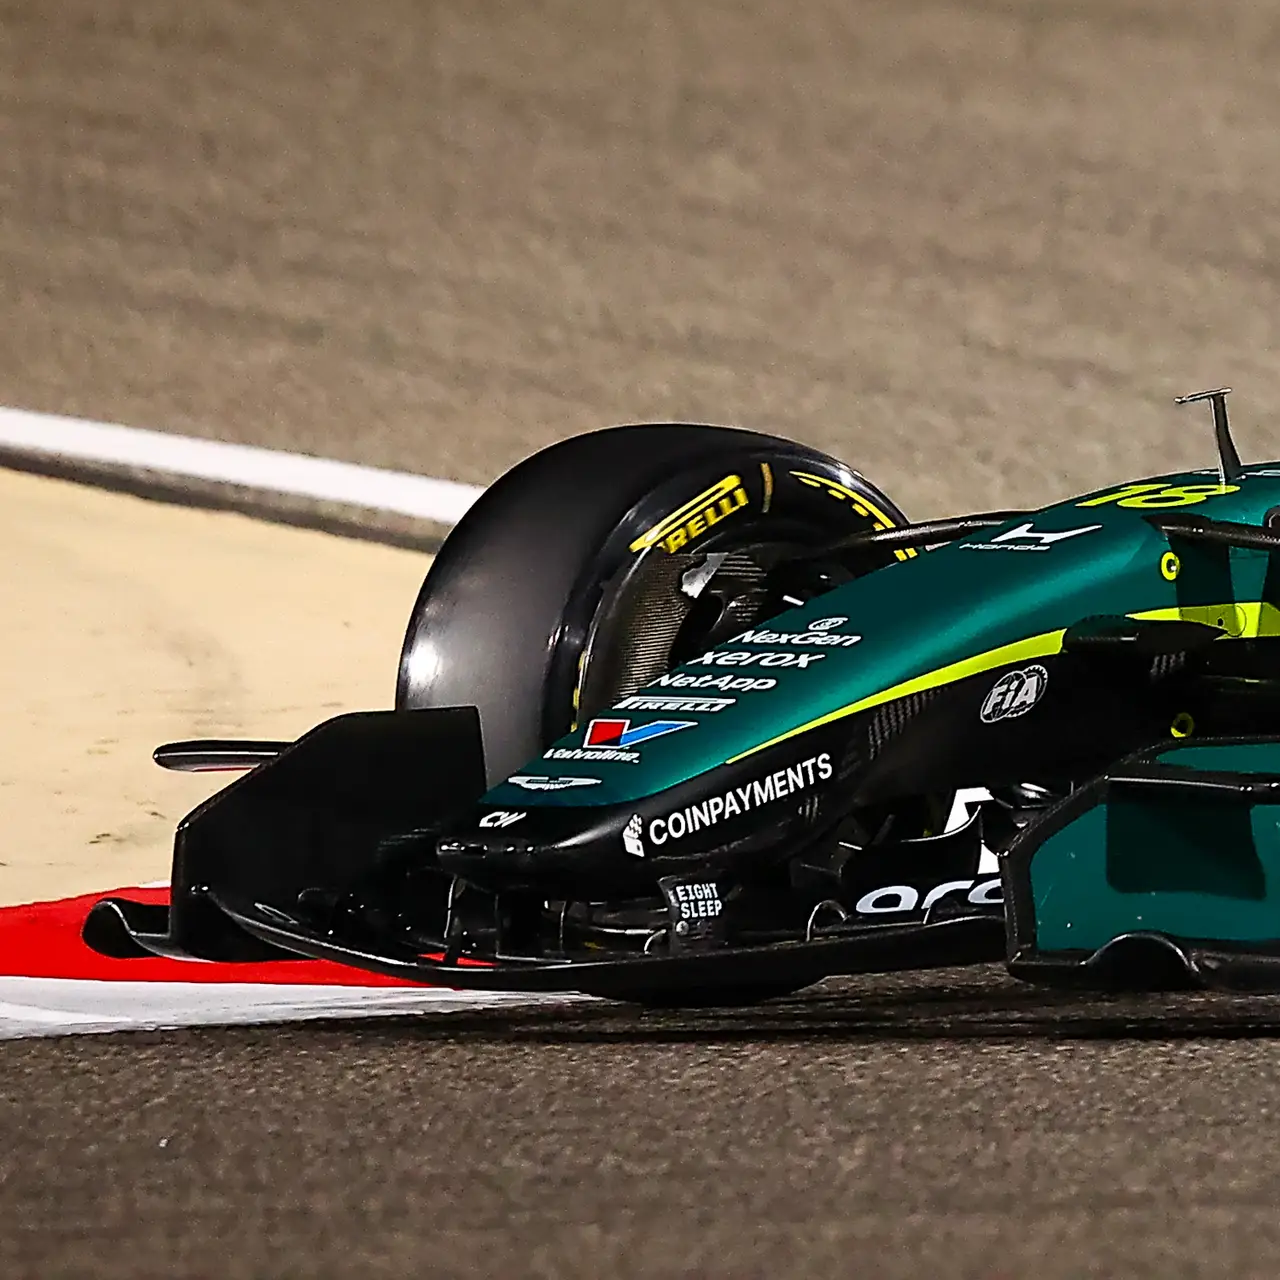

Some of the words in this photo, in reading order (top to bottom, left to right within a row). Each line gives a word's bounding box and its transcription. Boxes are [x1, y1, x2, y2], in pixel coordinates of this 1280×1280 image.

[1075, 483, 1241, 508] 18
[729, 629, 862, 647] NexGen
[688, 649, 826, 669] xerox
[648, 673, 778, 691] NetApp
[612, 696, 737, 713] PIRELLI
[649, 753, 833, 846] COINPAYMENTS
[676, 882, 718, 902] EIGHT
[855, 878, 1005, 914] ara
[680, 901, 723, 919] SLEEP
